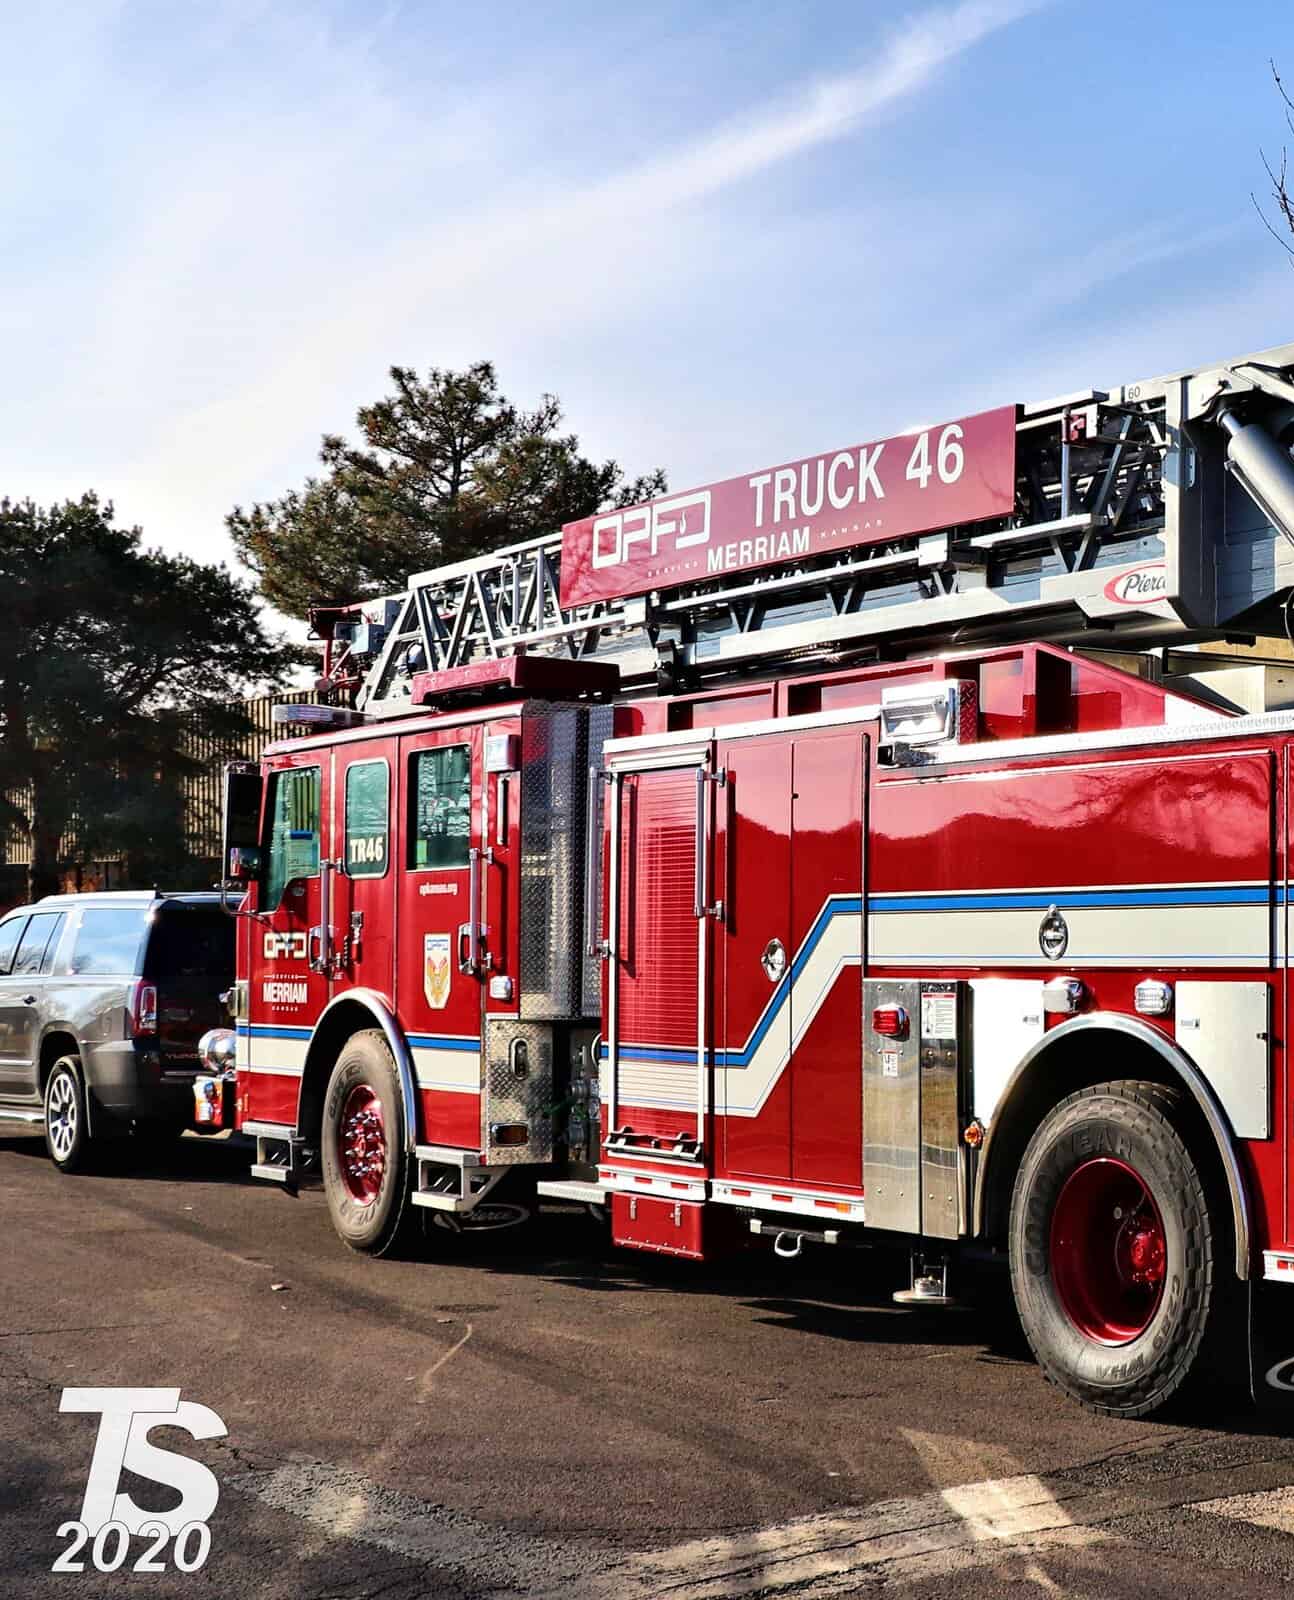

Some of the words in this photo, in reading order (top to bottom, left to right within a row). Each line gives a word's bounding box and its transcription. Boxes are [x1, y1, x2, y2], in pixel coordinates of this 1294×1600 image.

[1127, 385, 1141, 400] 60
[749, 443, 885, 528] TRUCK
[905, 424, 964, 489] 46
[706, 526, 811, 573] MERRIAM
[349, 836, 384, 863] TR46
[263, 982, 308, 1004] MERRIAM
